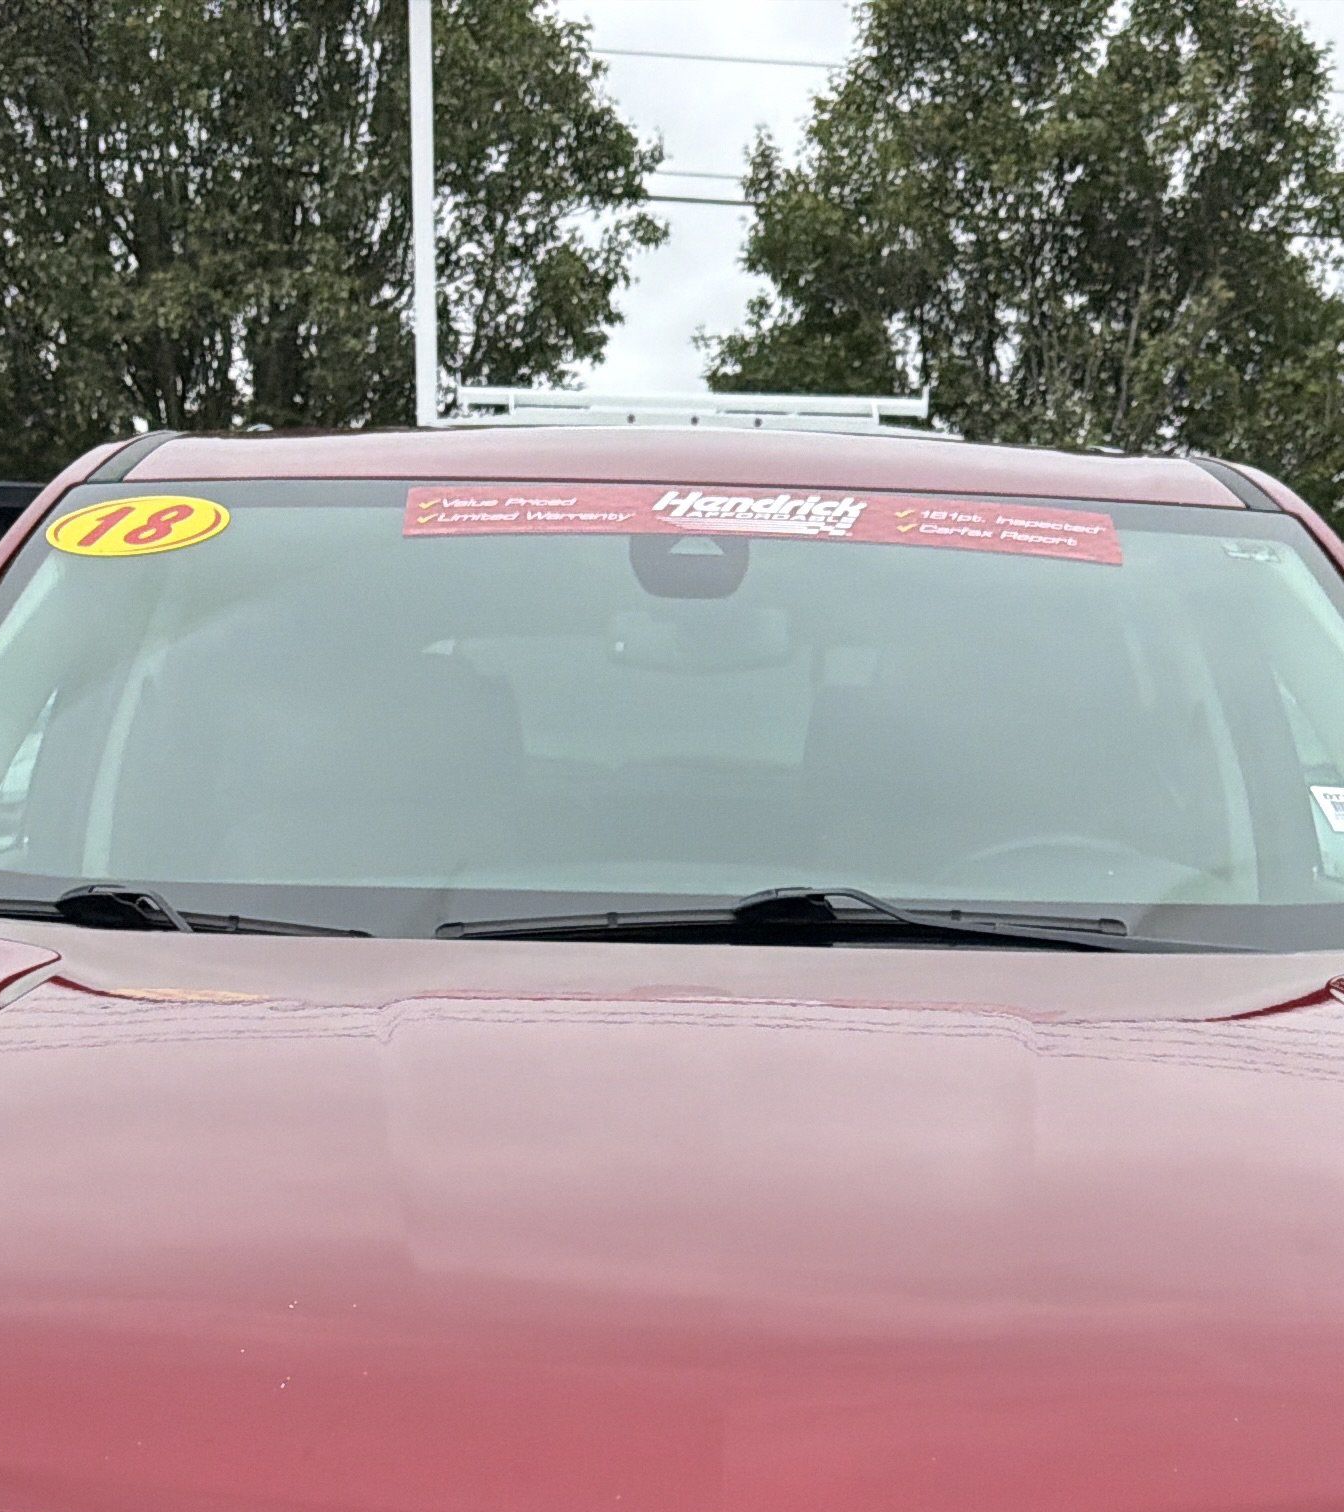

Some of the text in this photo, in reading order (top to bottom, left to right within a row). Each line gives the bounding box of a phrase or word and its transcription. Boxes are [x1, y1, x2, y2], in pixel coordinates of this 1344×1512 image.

[442, 497, 577, 508] Value Priced
[652, 490, 867, 517] Hendrick
[77, 505, 195, 548] 18
[437, 512, 519, 522] Limited
[919, 523, 1078, 547] Carfax Report
